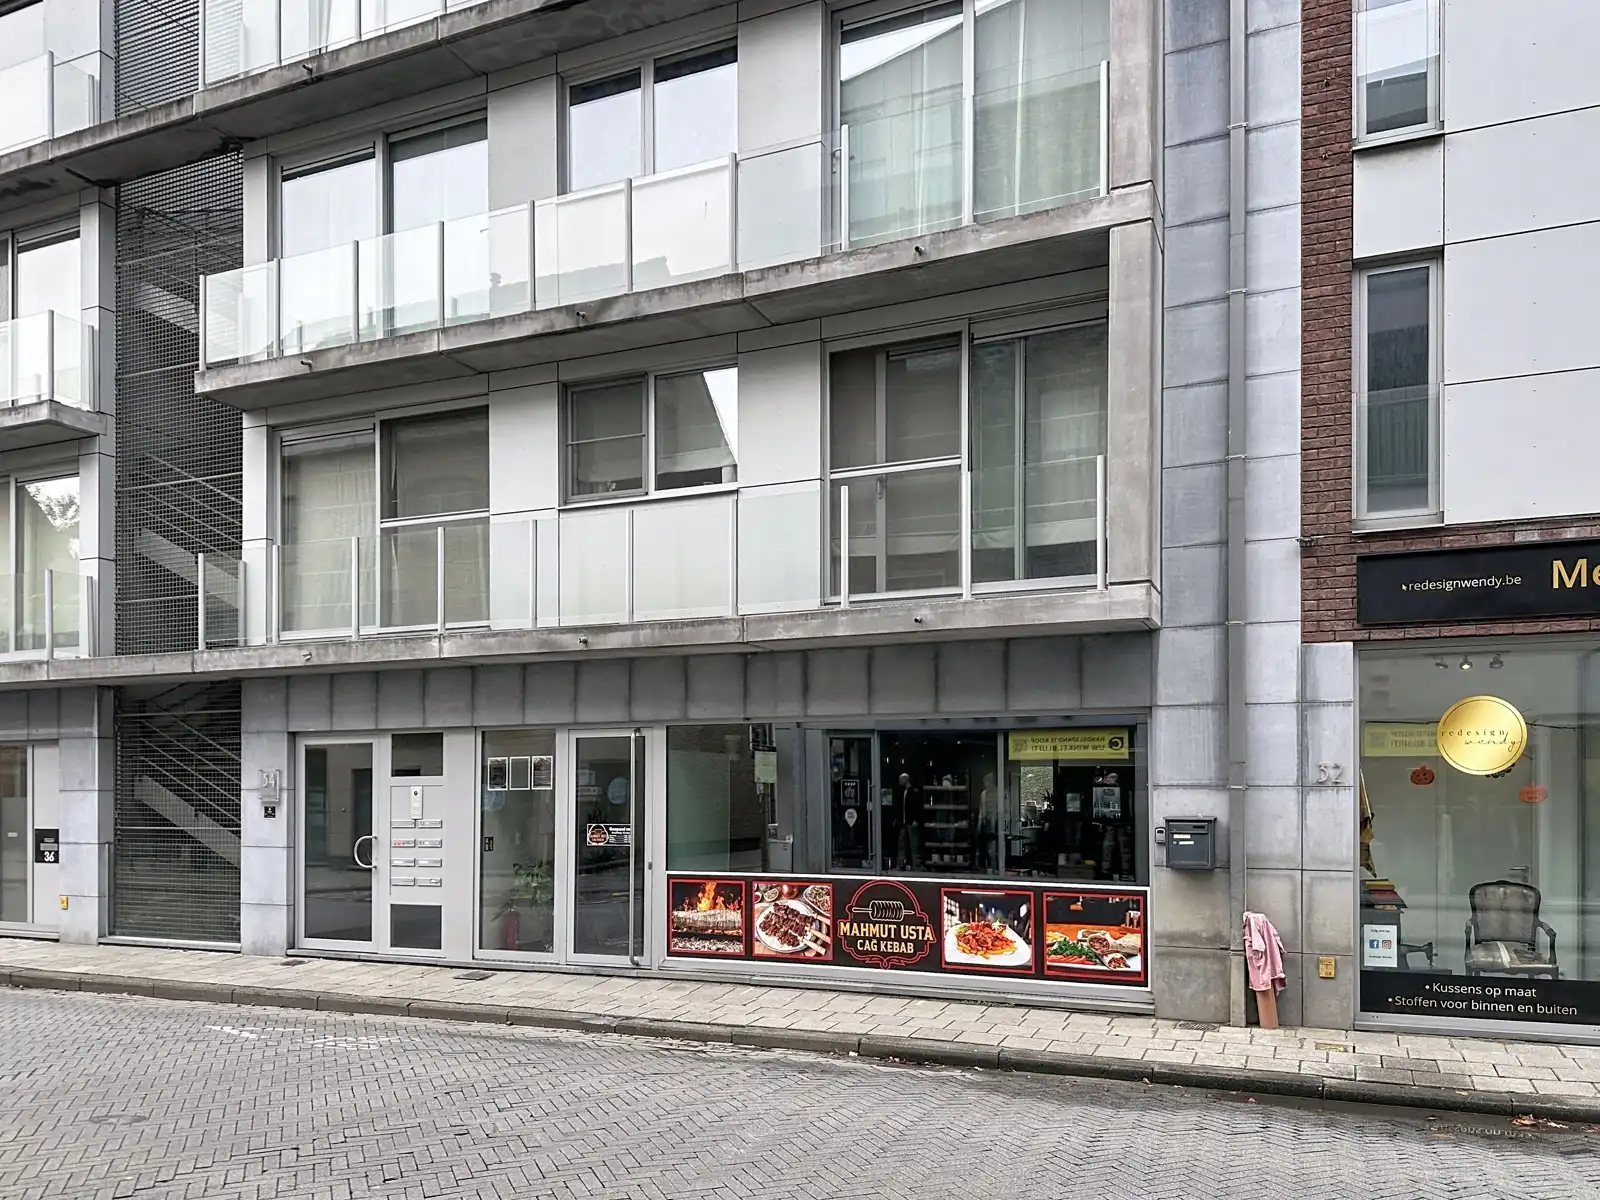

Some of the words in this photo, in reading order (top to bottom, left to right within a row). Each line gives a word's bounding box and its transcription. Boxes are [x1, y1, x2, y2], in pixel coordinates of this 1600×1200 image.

[1409, 575, 1522, 591] redesignwendy.be
[1441, 728, 1505, 737] redesign
[1464, 732, 1521, 752] wendy
[263, 773, 275, 787] 34
[1317, 762, 1342, 782] 32
[44, 851, 54, 862] 36
[840, 922, 896, 938] MAHMUT
[900, 925, 933, 940] USTA
[857, 939, 878, 951] CAĞ
[880, 941, 914, 953] KEBAB
[1432, 982, 1482, 994] Kussens
[1485, 987, 1501, 996] op
[1505, 986, 1537, 998] maat
[1394, 995, 1437, 1008] Stoffen
[1440, 1001, 1469, 1009] voor
[1472, 1000, 1514, 1012] binnen
[1518, 1004, 1533, 1013] en
[1537, 1004, 1578, 1015] buiten
